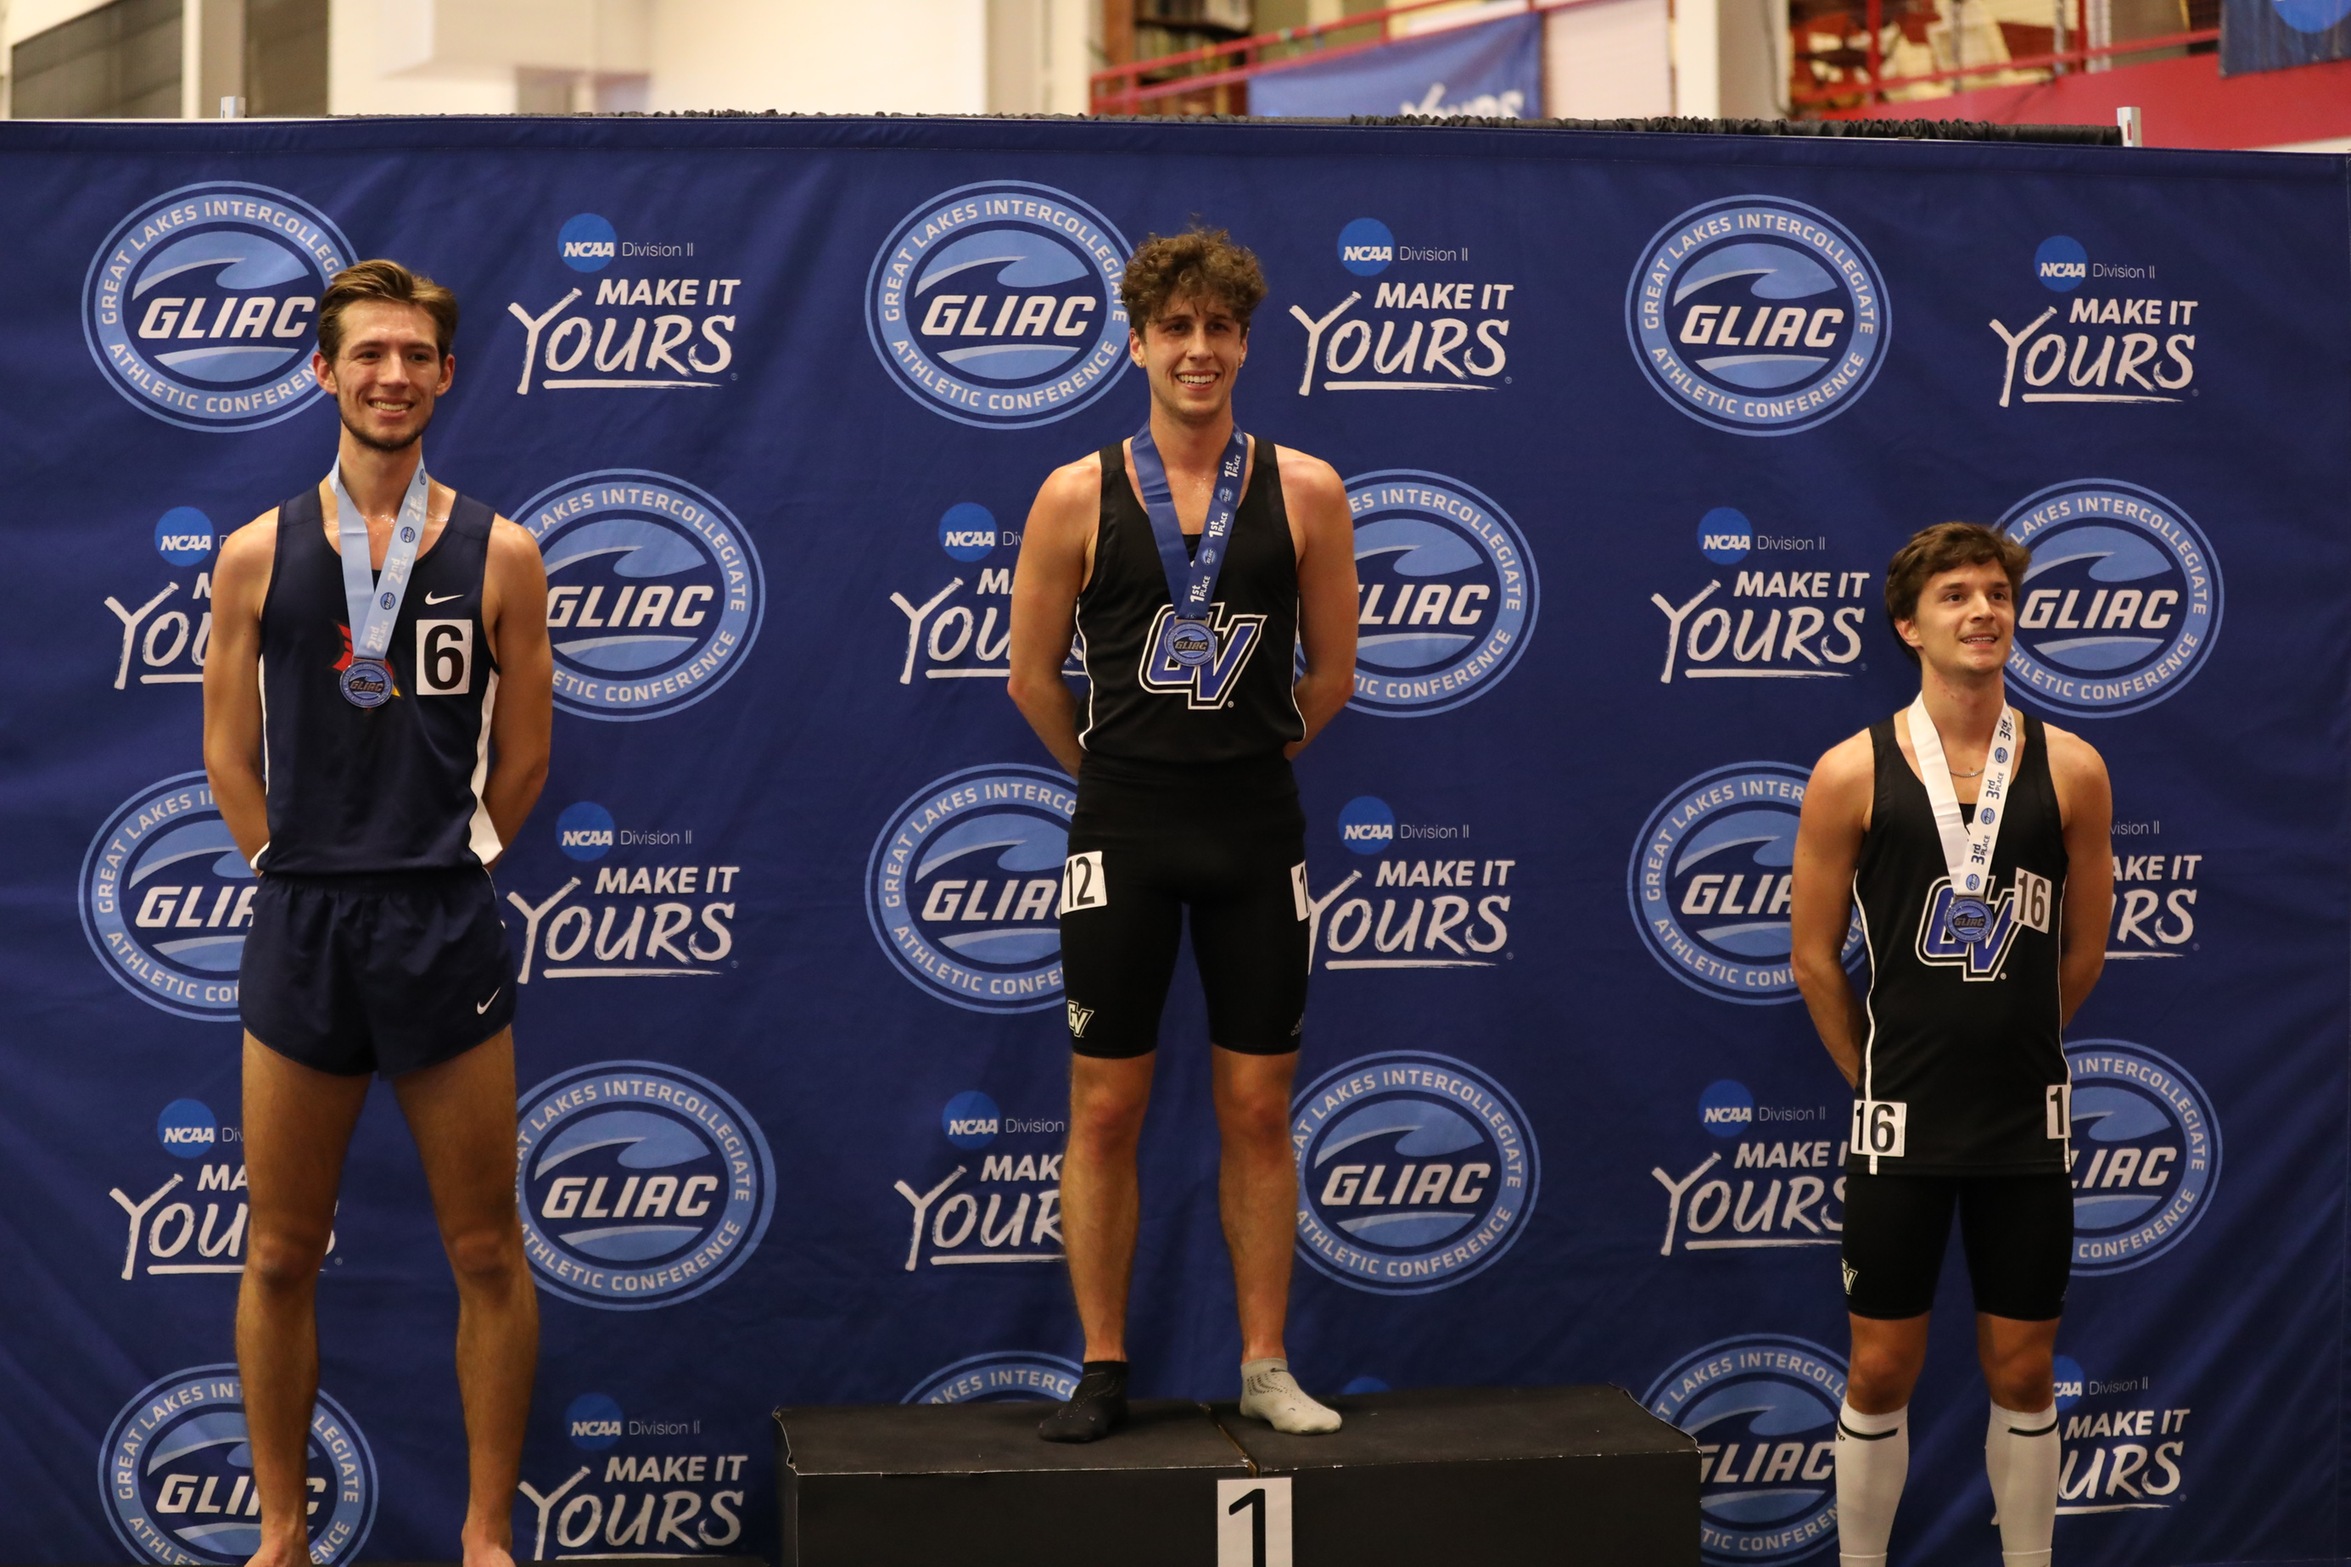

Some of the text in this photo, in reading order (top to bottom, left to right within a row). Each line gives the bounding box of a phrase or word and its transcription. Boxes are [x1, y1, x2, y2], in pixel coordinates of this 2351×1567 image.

[102, 201, 340, 325] GREAT LAKES INTERCOLLEG
[564, 242, 614, 257] NCAA
[622, 243, 681, 256] Division
[885, 204, 978, 321] GREAT LAKES
[1344, 246, 1392, 261] NCAA
[1400, 247, 1456, 261] Division
[1644, 214, 1874, 334] GREAT LAKES INTERCOLLEGIATE
[2040, 263, 2086, 278] NCAA
[2093, 264, 2144, 279] Division
[595, 279, 741, 305] MAKE IT
[1374, 282, 1514, 310] MAKE IT
[2069, 298, 2198, 325] MAKE IT
[138, 297, 315, 339] GLIAC
[921, 295, 1096, 336] GLIAC
[1679, 305, 1844, 348] GLIAC
[508, 288, 736, 395] YOURS
[1289, 291, 1510, 396] YOURS
[1989, 306, 2195, 408] YOURS
[109, 343, 316, 413] ATHLETIC CONFEREN
[893, 340, 1117, 410] ATHLETIC CONFERENCE
[1652, 348, 1864, 417] ATHLETIC CONFERENCE
[1224, 462, 1237, 477] 1st
[1233, 455, 1241, 473] PLACE
[945, 532, 995, 546] NCAA
[1209, 521, 1223, 537] 1st
[1218, 512, 1228, 532] PLACE
[1703, 535, 1750, 549] NCAA
[1758, 536, 1813, 550] Division
[160, 536, 211, 551] NCAA
[528, 489, 745, 612] LAKES INTERCOLLEGIATE
[1382, 489, 1521, 611] INTERCOLLEGIATE
[2010, 497, 2207, 614] LAKES INTERCOLLEGIATE
[1190, 585, 1204, 602] 1st
[1200, 576, 1210, 596] PLACE
[1358, 584, 1490, 625] LIAC
[1734, 571, 1870, 598] MAKE IT
[547, 586, 714, 627] GLIAC
[2019, 590, 2179, 629] GLIAC
[890, 577, 1010, 684] YOU
[1175, 641, 1208, 650] GLIAC
[1651, 580, 1865, 683] YOURS
[424, 625, 464, 690] 6
[552, 631, 735, 702] ETIC CONFERENCE
[1386, 629, 1511, 699] CONFERENCE
[2010, 633, 2197, 700] HLETIC CONFERENCE
[350, 680, 383, 692] GLIAC
[2000, 720, 2011, 741] 3rd
[1986, 780, 1999, 799] 3rd
[1995, 773, 2004, 791] PLACE
[562, 831, 613, 846] NCAA
[621, 831, 679, 845] Division
[885, 788, 977, 907] GREAT LAKES
[1344, 825, 1393, 840] NCAA
[1401, 825, 1457, 838] Division
[1646, 785, 1734, 900] GREAT LAKES
[1981, 835, 1990, 855] PLACE
[2111, 821, 2149, 835] vision
[98, 794, 192, 913] GREAT LAKES
[1375, 861, 1515, 887] MAKE IT
[1971, 844, 1985, 865] 3rd
[2113, 855, 2202, 881] AKE IT
[595, 867, 740, 894] MAKE IT
[921, 880, 1061, 921] GLIA
[1065, 856, 1095, 908] 12
[2018, 873, 2046, 927] 16
[135, 887, 258, 927] GLIA
[1308, 870, 1511, 975] YOURS
[1954, 917, 1985, 926] GLIAC
[507, 877, 735, 984] YOURS
[107, 932, 197, 999] ATHLETIC
[894, 926, 1064, 994] ATHLETIC CONFE
[1655, 919, 1739, 986] ATHLETIC
[949, 1118, 1064, 1135] NCAA Division
[1311, 1070, 1522, 1188] LAKES INTERCOLLEGIATE
[1704, 1108, 1752, 1122] NCAA
[1759, 1107, 1814, 1121] Division
[1856, 1102, 1895, 1153] 16
[2050, 1087, 2064, 1135] 1
[2078, 1058, 2205, 1170] INTERCOLLEGIATE
[164, 1128, 214, 1143] NCAA
[531, 1080, 749, 1201] LAKES INTERCOLLEGIATE
[1734, 1142, 1830, 1168] MAKE
[197, 1165, 249, 1191] MA
[980, 1155, 1063, 1182] MAK
[1321, 1164, 1491, 1205] GLIAC
[542, 1176, 718, 1218] GLIAC
[109, 1173, 248, 1281] YOU
[894, 1166, 1065, 1271] YOUR
[2079, 1189, 2195, 1257] CONFERENCE
[612, 1221, 740, 1291] CONFERENCE
[1296, 1206, 1511, 1277] ATHLETIC CONFERENCE
[1670, 1353, 1846, 1402] LAKES INTERCOLL
[2090, 1378, 2137, 1395] Division
[118, 1386, 204, 1499] GREAT LAKES
[571, 1422, 621, 1436] NCAA
[629, 1421, 688, 1435] Division
[2064, 1409, 2190, 1440] MAKE IT
[604, 1456, 748, 1482] MAKE IT
[2059, 1441, 2183, 1500] URS
[518, 1466, 743, 1560] YOURS
[1229, 1488, 1266, 1567] 1
